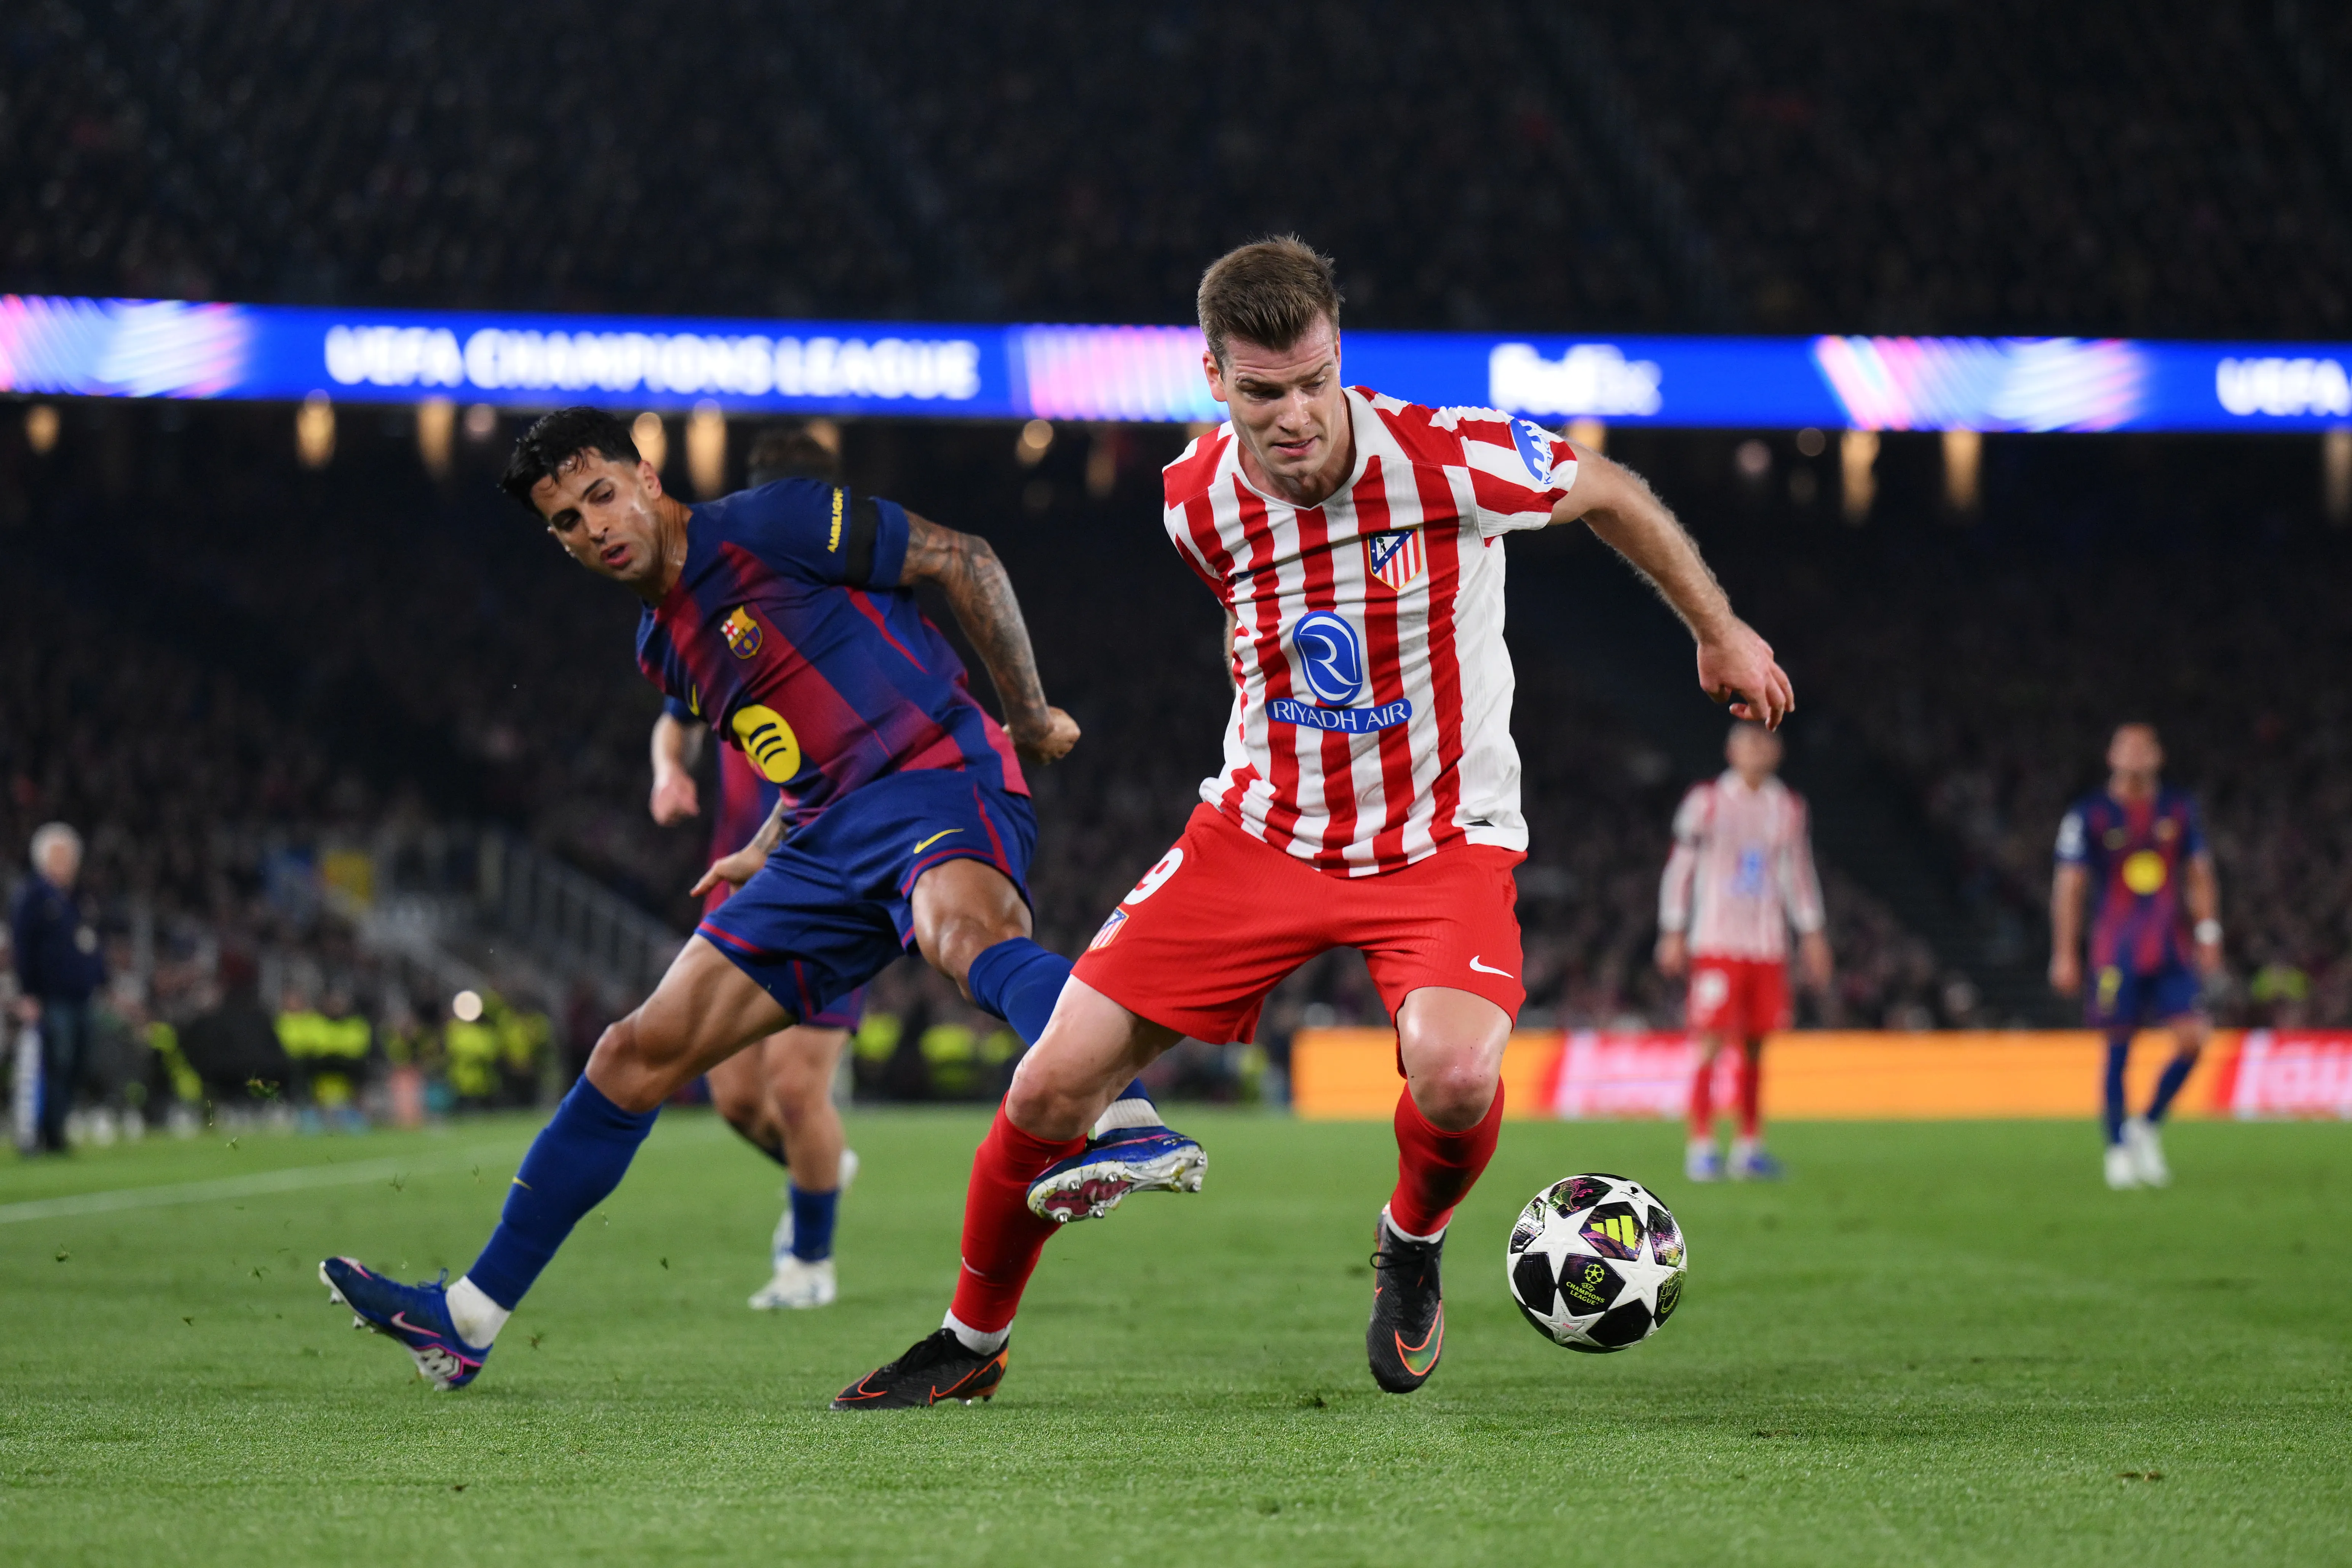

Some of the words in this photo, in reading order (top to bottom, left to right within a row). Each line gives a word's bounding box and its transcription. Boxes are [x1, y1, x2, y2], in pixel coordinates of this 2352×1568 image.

[324, 325, 463, 388] UEFA
[463, 328, 774, 395] CHAMPIONS
[775, 336, 981, 400] LEAGUE
[2216, 357, 2351, 417] UEFA
[1273, 700, 1358, 730] RIYADH
[1365, 702, 1408, 730] AIR
[1123, 847, 1184, 905] 9
[1566, 1281, 1605, 1303] CHAMPIONS
[1570, 1290, 1596, 1306] LEAGUE
